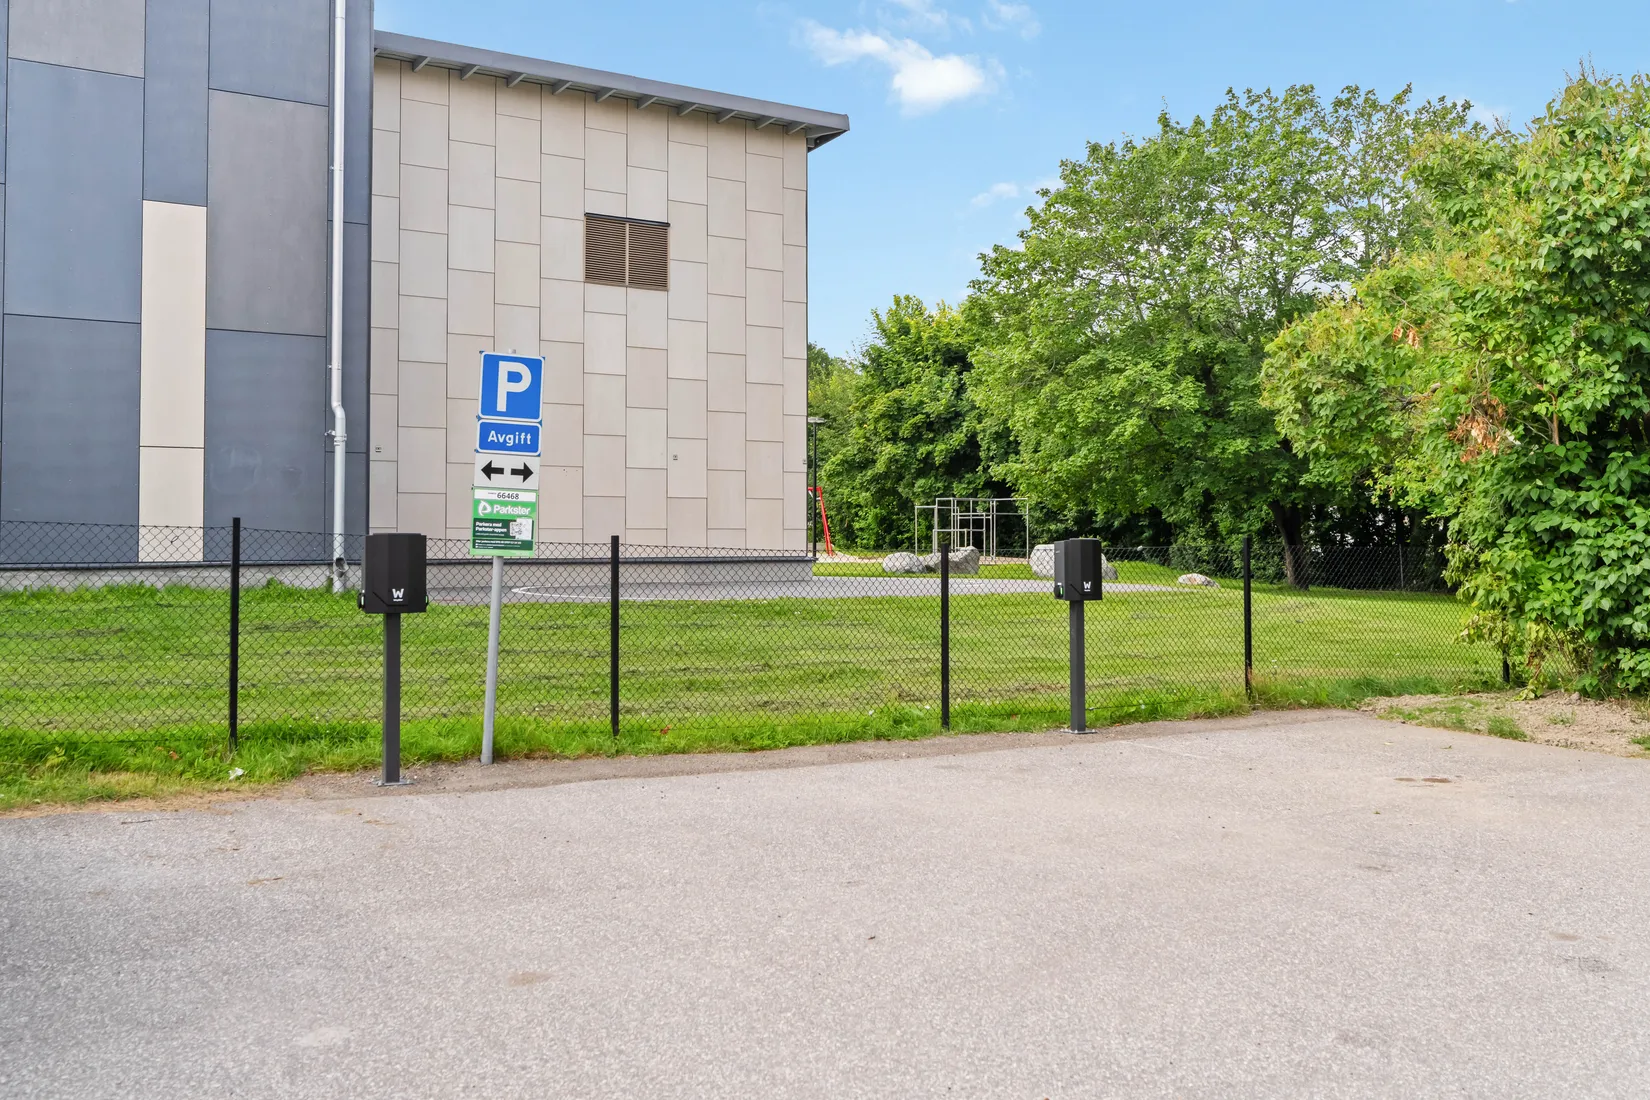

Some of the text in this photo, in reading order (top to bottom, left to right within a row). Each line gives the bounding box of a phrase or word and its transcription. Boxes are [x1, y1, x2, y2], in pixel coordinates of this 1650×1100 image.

[496, 360, 532, 412] P
[487, 430, 532, 447] Avgift
[494, 504, 530, 514] Parkster
